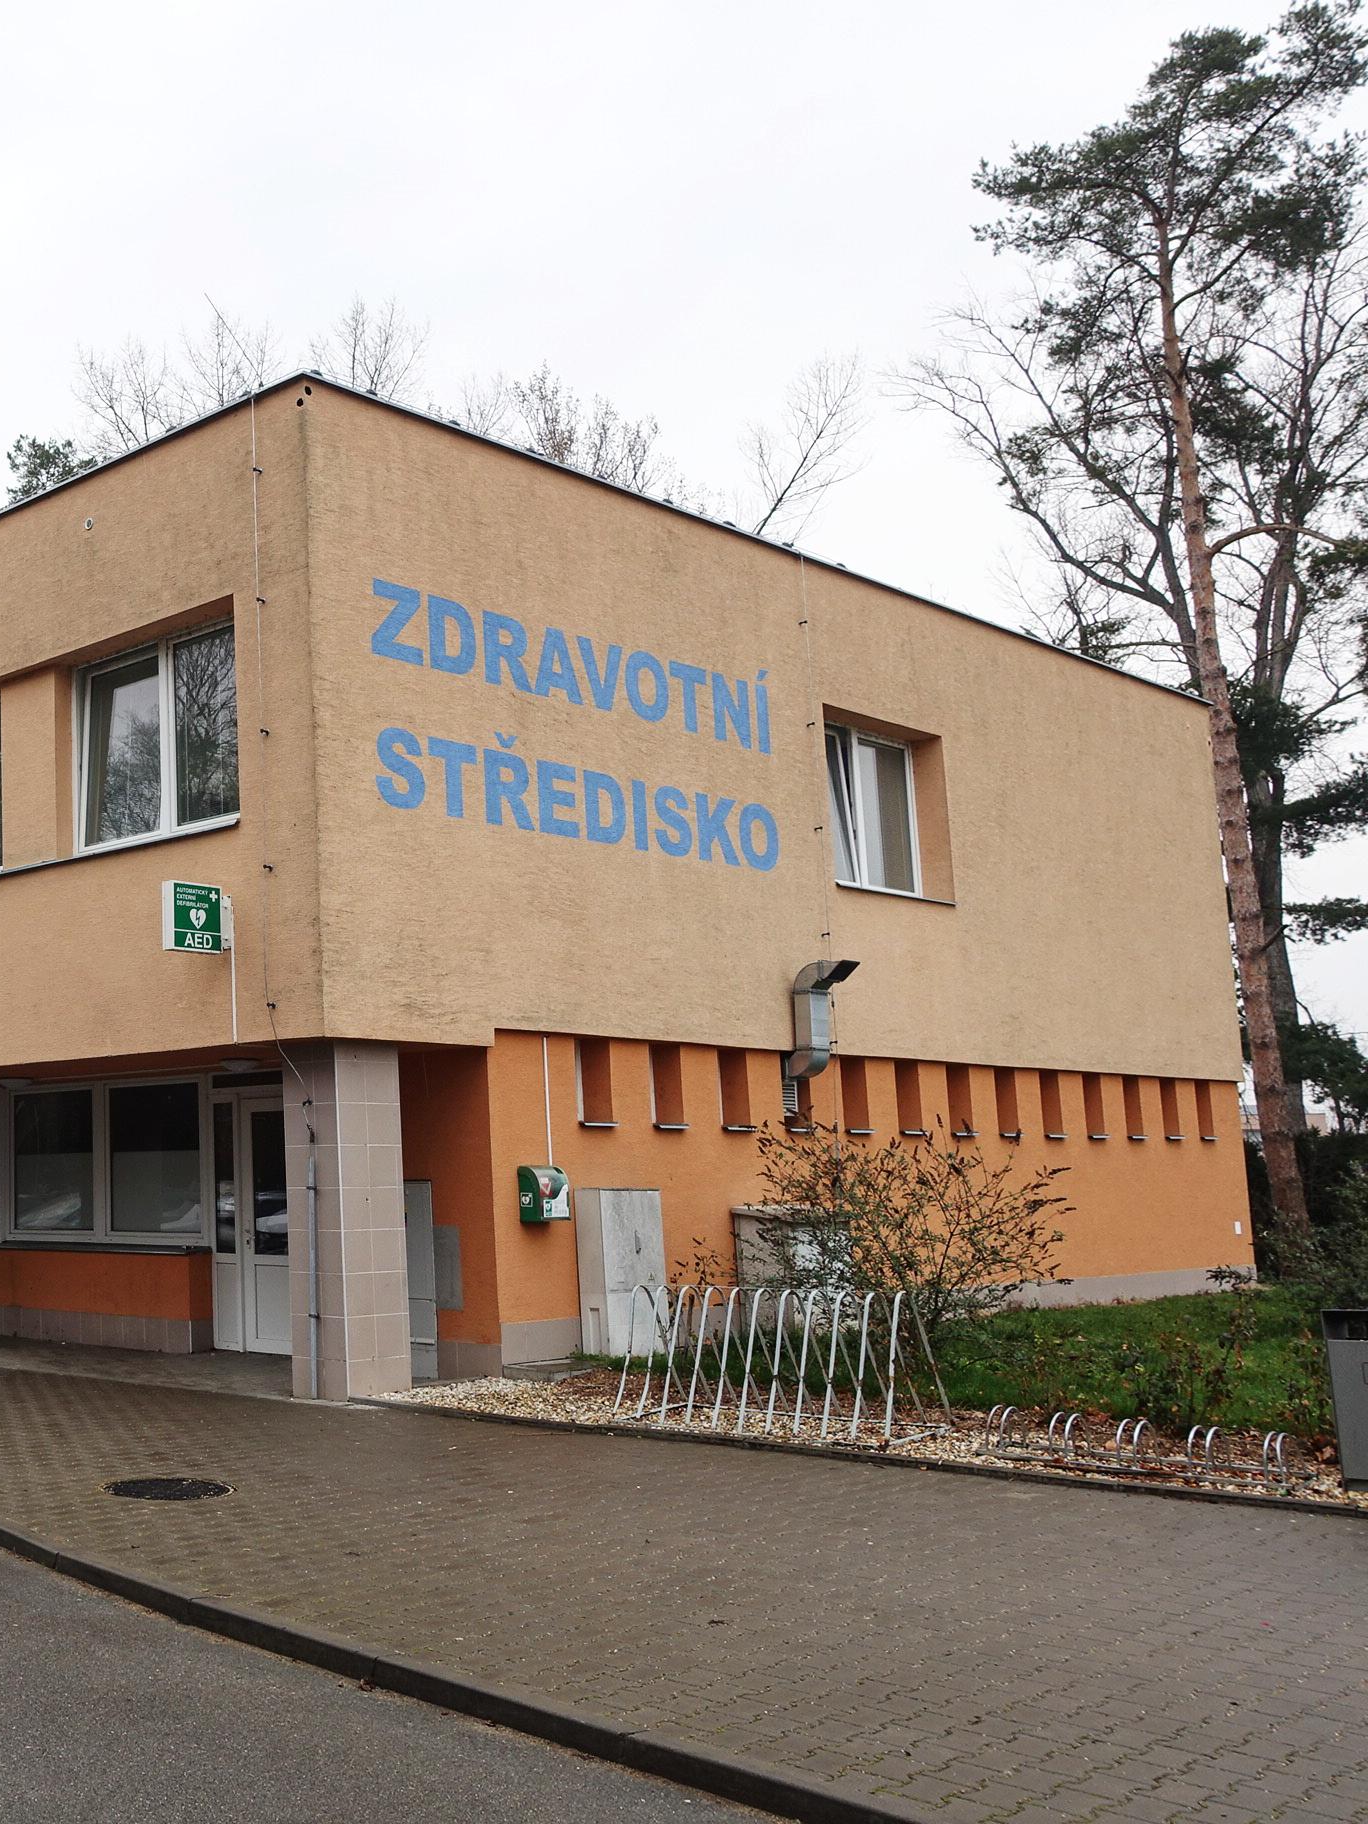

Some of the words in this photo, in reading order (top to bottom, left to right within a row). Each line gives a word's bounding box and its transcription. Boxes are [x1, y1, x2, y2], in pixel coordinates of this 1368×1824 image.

[371, 577, 771, 755] ZDRAVOTNÍ
[375, 727, 780, 872] STŘEDISKO
[176, 887, 208, 895] AUTOMATICKÝ
[176, 900, 209, 908] DEFIBRILÁTOR
[184, 933, 212, 948] AED
